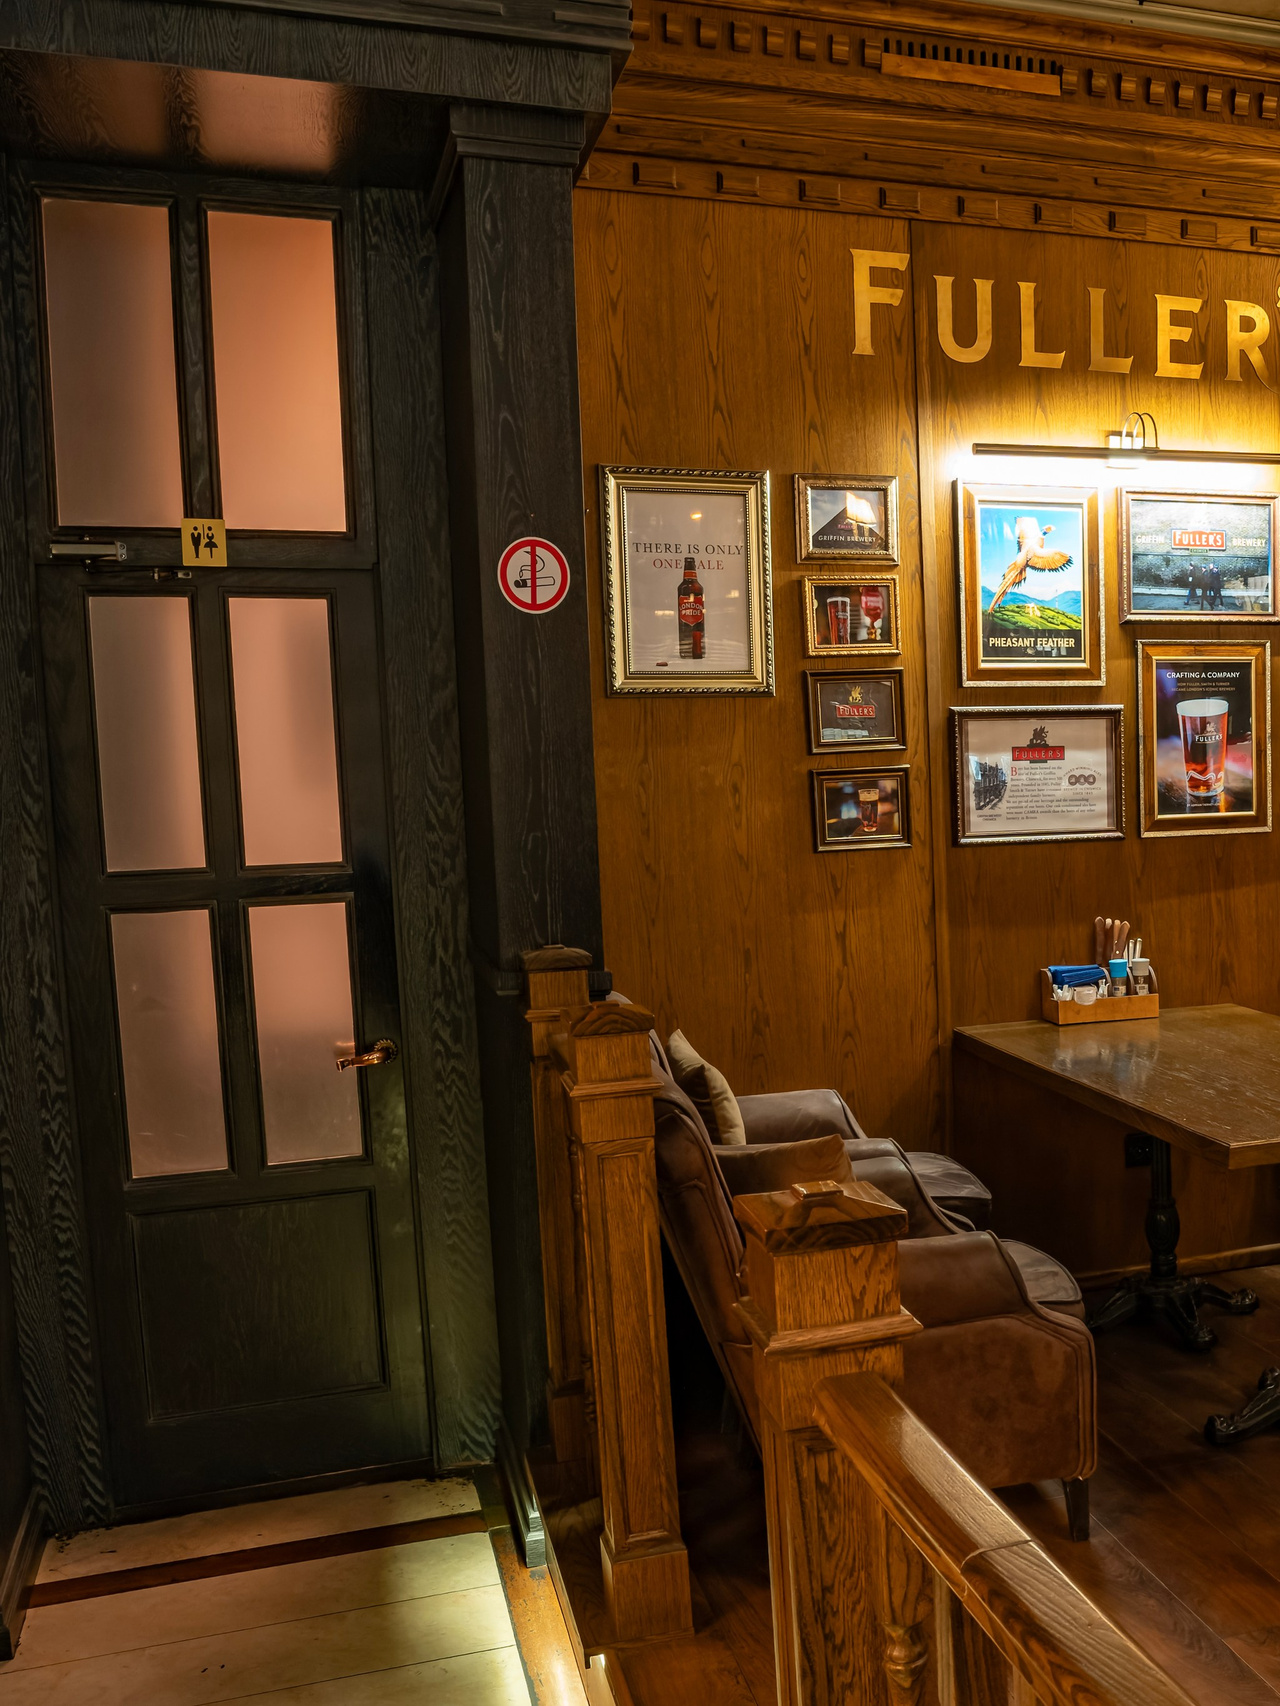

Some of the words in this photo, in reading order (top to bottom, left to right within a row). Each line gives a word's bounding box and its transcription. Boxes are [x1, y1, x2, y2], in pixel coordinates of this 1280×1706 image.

[1175, 532, 1222, 547] FULLER'S
[633, 543, 682, 554] THERE
[687, 544, 700, 554] IS
[705, 545, 743, 555] ONLY
[653, 558, 683, 569] ONE
[697, 560, 724, 570] ALE
[989, 638, 1035, 647] PHEASANT
[1037, 638, 1075, 647] FEATHER
